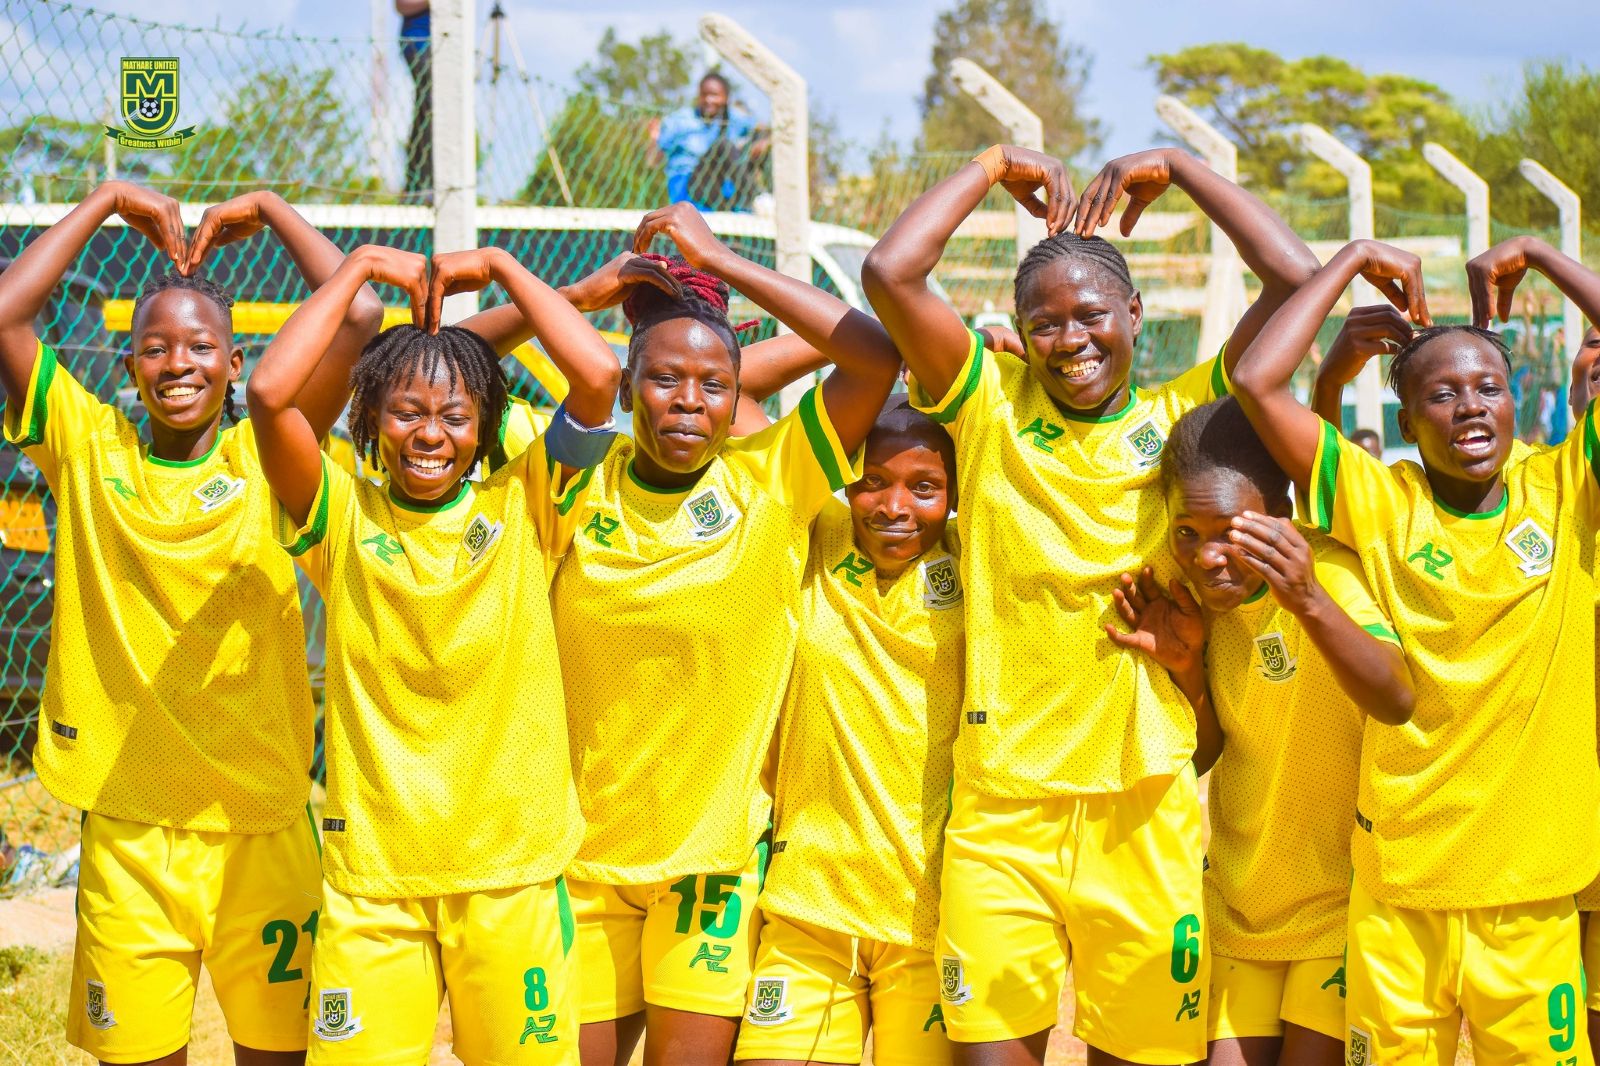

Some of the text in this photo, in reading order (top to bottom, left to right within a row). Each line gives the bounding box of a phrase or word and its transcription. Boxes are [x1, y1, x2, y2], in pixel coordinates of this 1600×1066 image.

[669, 874, 742, 939] 15
[1171, 913, 1200, 983] 6
[523, 966, 548, 1011] 8
[1548, 983, 1575, 1052] 9
